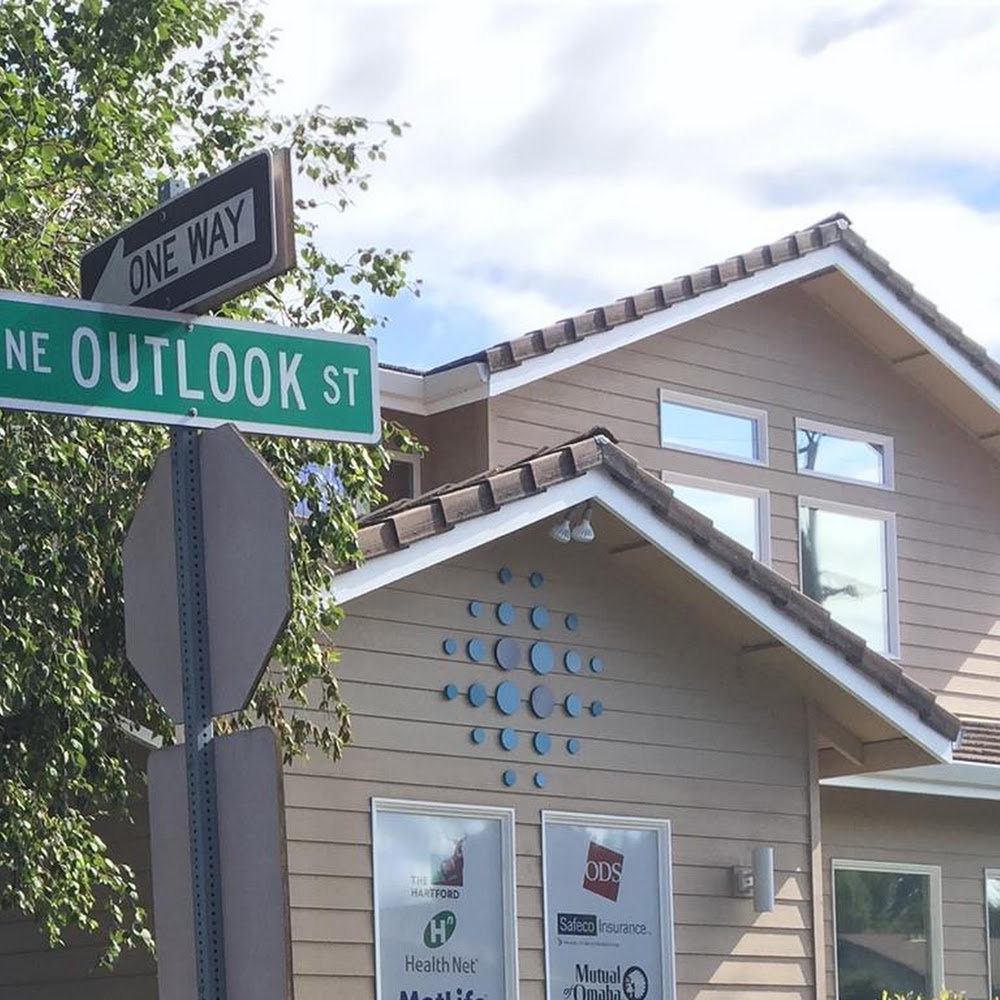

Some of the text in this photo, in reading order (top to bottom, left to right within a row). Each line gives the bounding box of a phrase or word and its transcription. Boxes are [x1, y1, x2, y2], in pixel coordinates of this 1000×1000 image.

[128, 199, 246, 297] ONE WAY
[4, 325, 360, 412] NE OUTLOOK ST
[585, 860, 622, 883] ODS
[410, 888, 460, 900] HARTFORD
[560, 917, 648, 936] Safeco Insurance
[405, 954, 477, 975] Health Net
[575, 963, 621, 985] Mutual
[562, 984, 574, 1000] of
